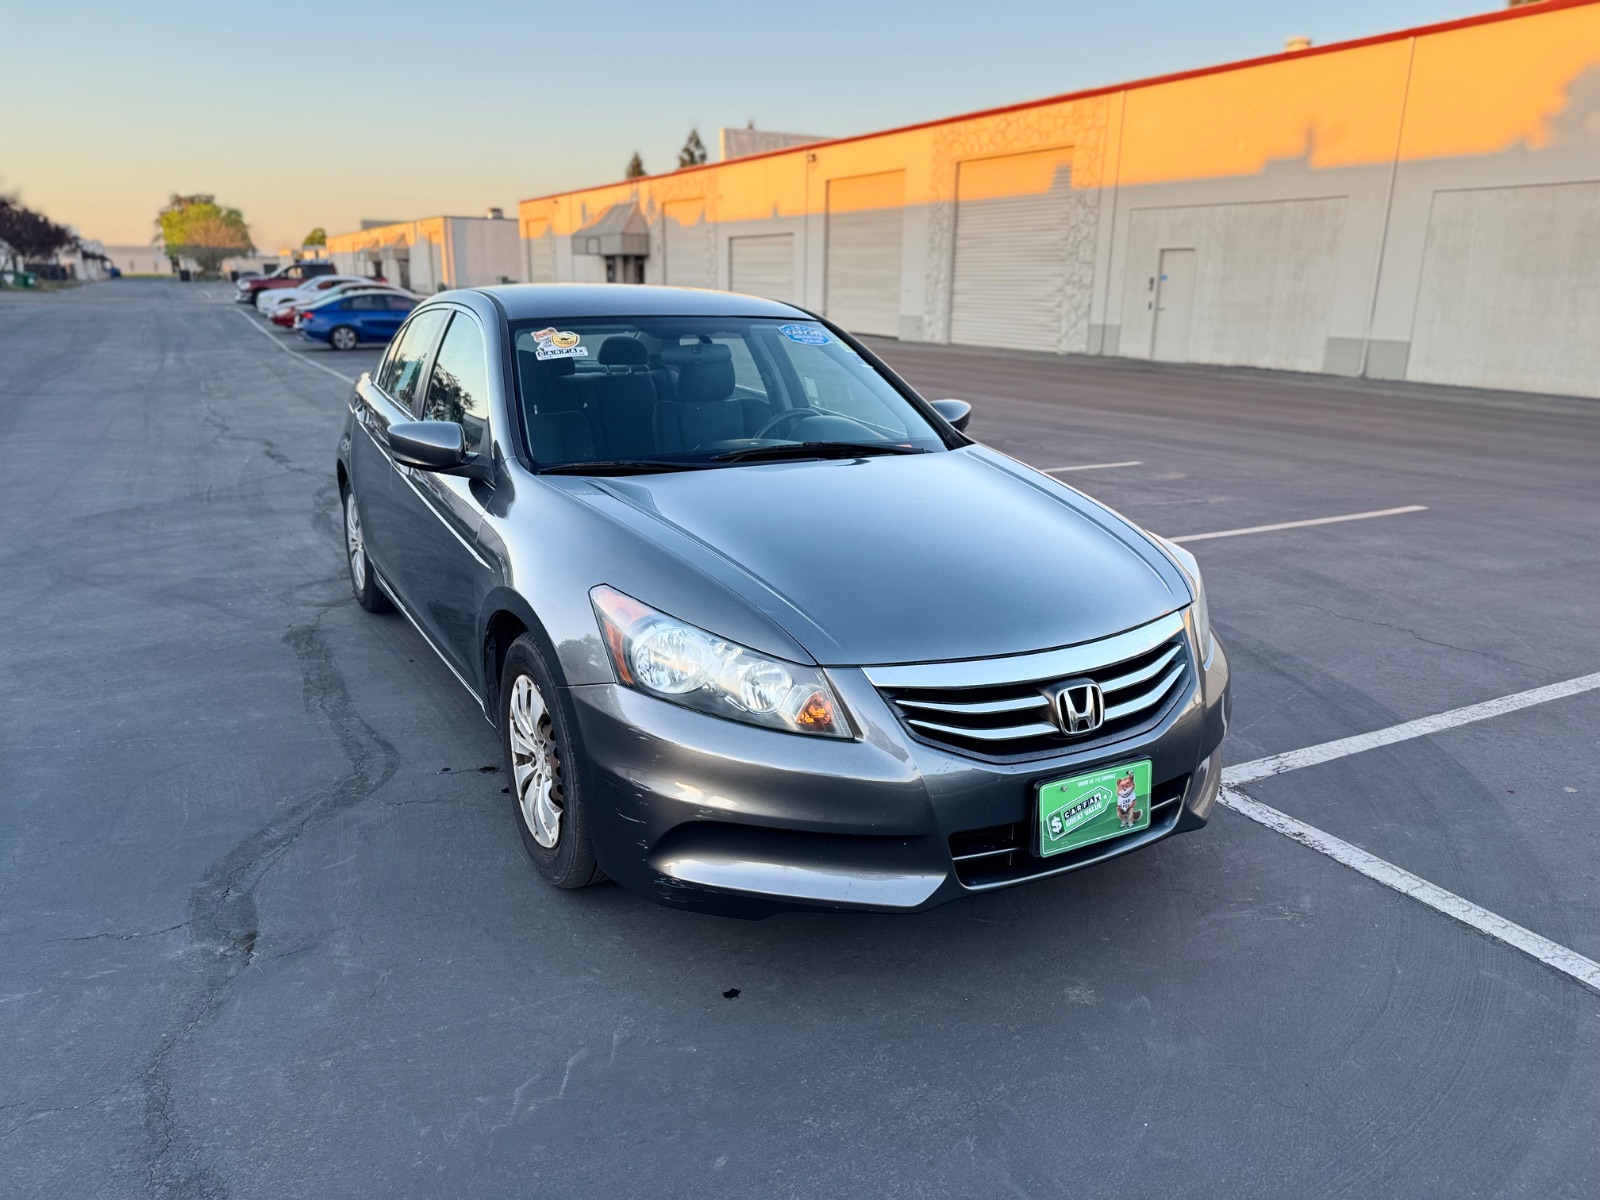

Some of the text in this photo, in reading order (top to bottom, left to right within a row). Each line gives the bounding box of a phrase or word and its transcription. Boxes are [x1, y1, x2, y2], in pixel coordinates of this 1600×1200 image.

[1064, 793, 1101, 819] CARFAX
[1065, 801, 1103, 827] GREAT VALUE
